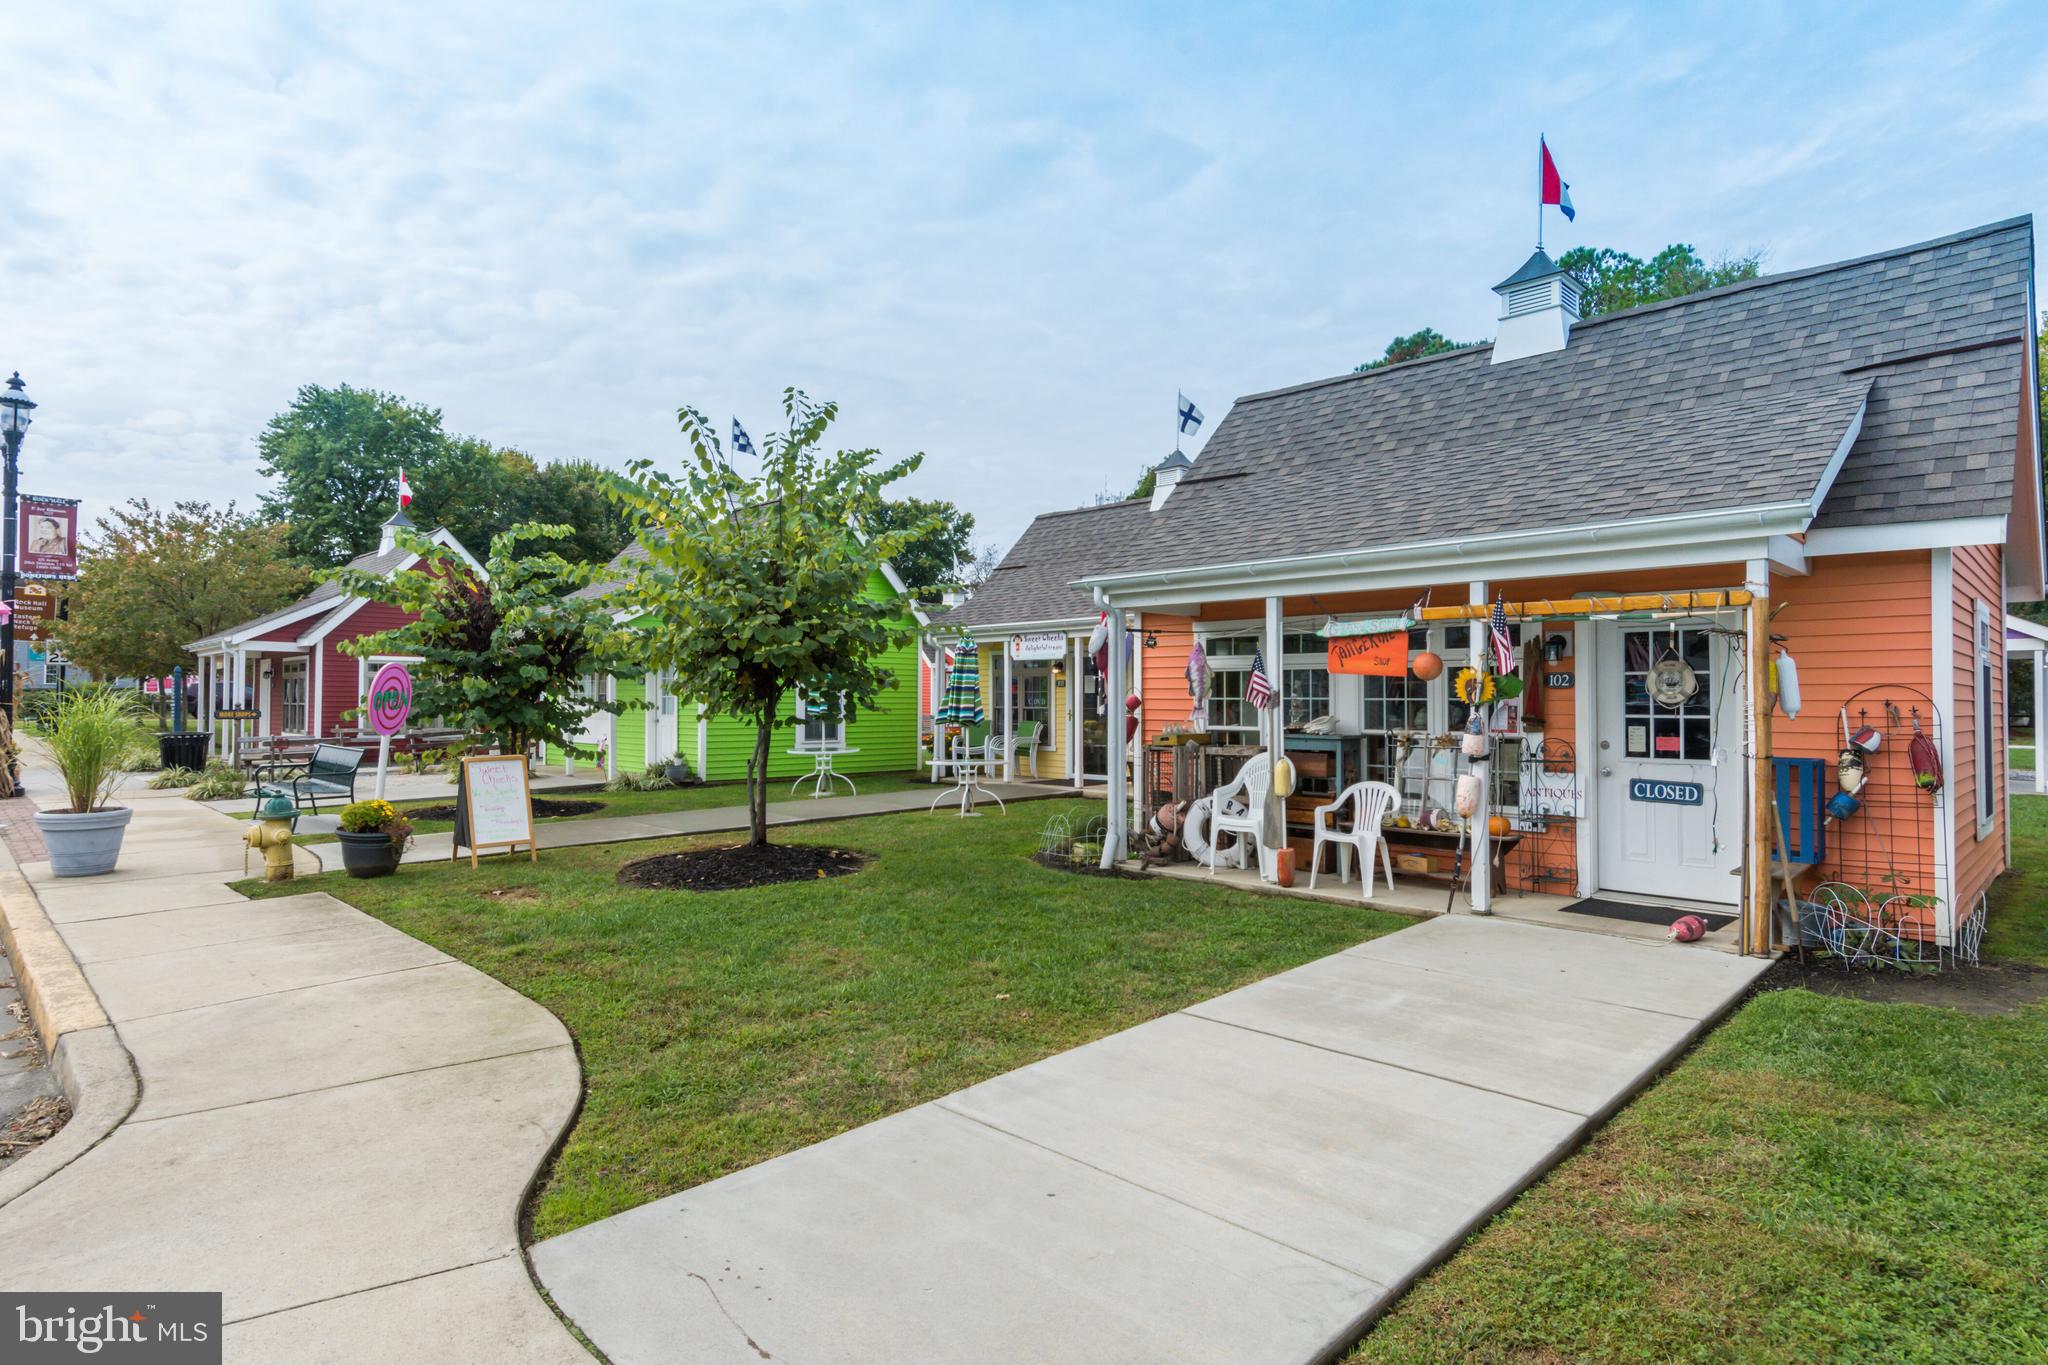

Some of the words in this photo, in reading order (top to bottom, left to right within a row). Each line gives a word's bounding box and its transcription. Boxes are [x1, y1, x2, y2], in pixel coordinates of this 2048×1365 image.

[1549, 674, 1570, 687] 102
[374, 688, 409, 712] OPEN
[1524, 786, 1583, 801] ANTIQUES
[1634, 782, 1699, 802] CLOSED
